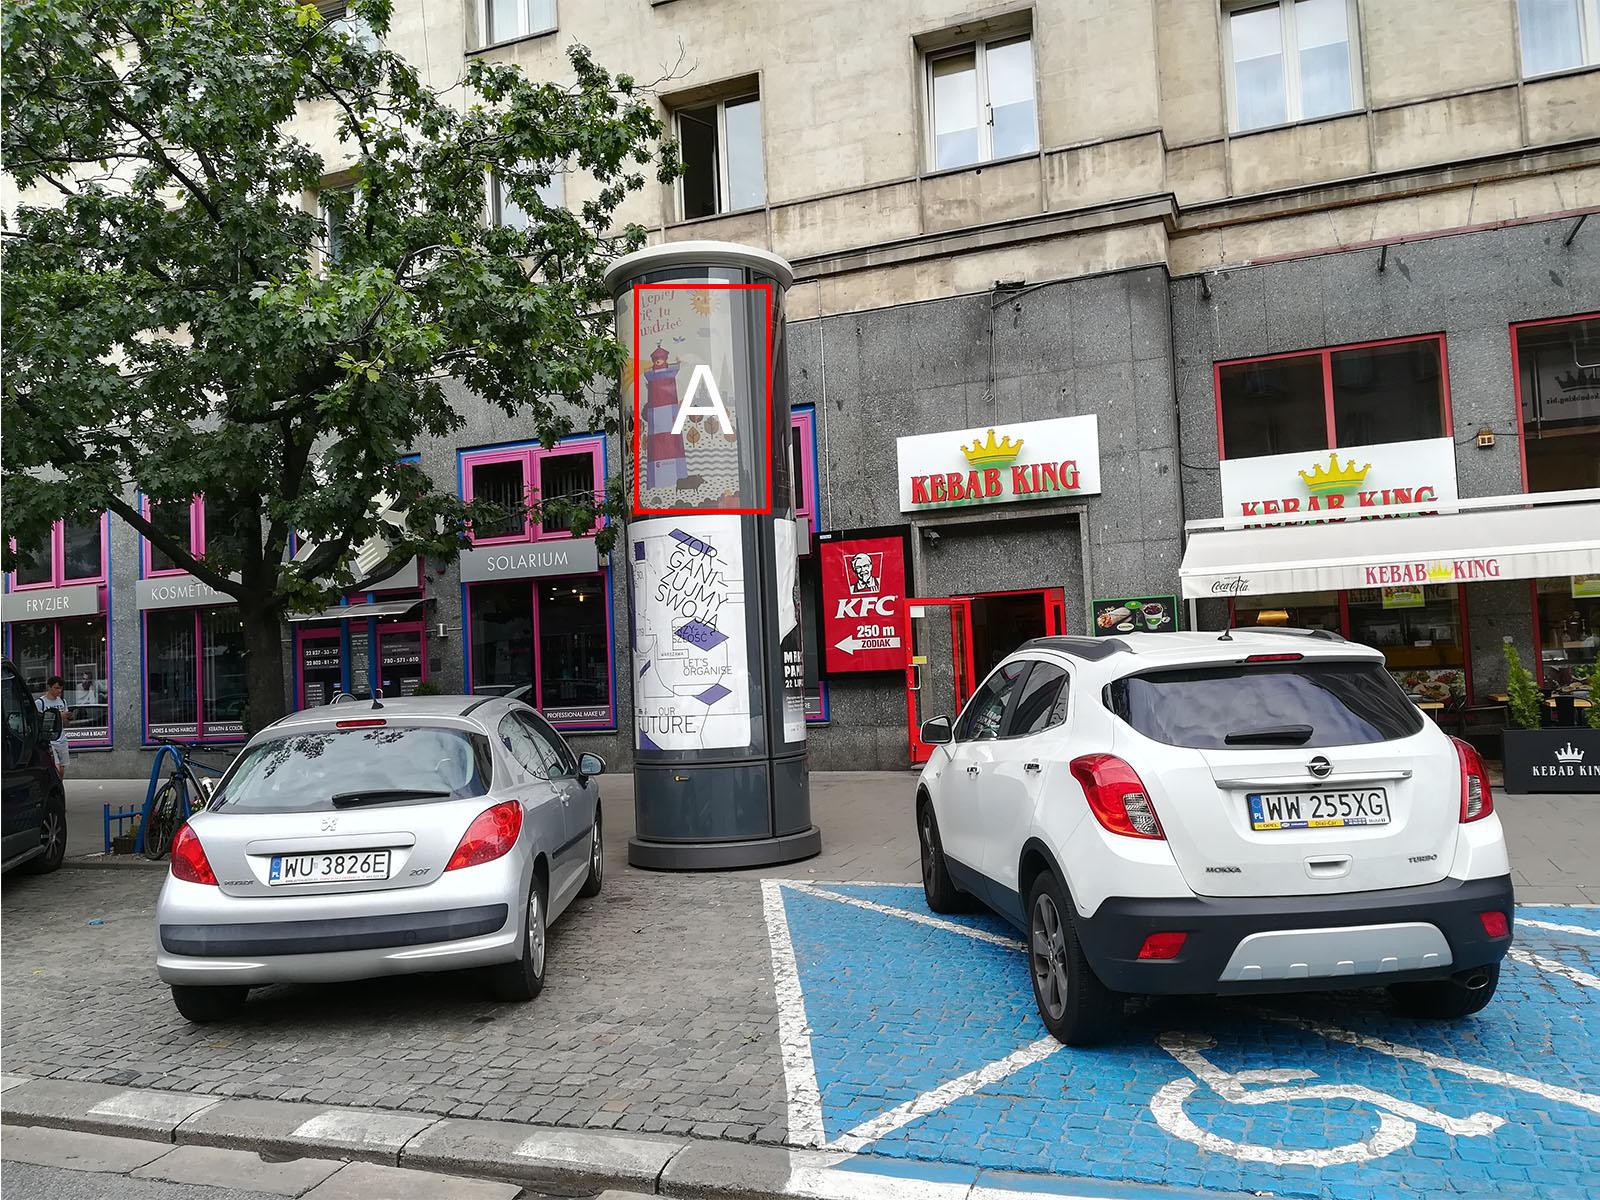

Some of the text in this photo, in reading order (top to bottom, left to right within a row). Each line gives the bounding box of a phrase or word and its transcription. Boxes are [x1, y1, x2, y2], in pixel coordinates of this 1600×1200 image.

[639, 307, 671, 321] ię tu
[911, 460, 1081, 504] KEBAB KING
[487, 551, 569, 572] SOLARIUM
[1365, 558, 1500, 585] KEBAB KING
[151, 582, 220, 601] KOSMETYK
[660, 565, 729, 612] ZUJMY
[26, 596, 70, 612] FRYZJER
[655, 583, 719, 636] SWOJĄ
[834, 594, 897, 619] KFC
[856, 624, 895, 638] 250 m
[861, 638, 891, 648] ZODIAK
[682, 658, 709, 668] LET'S
[682, 665, 733, 677] ORGANISE
[546, 711, 583, 719] PROFESSIONAL
[658, 706, 676, 716] OUR
[1532, 765, 1575, 776] KEBAB
[1265, 792, 1383, 821] WW 255XG
[1253, 812, 1264, 820] PL
[284, 853, 386, 878] WU 3826E
